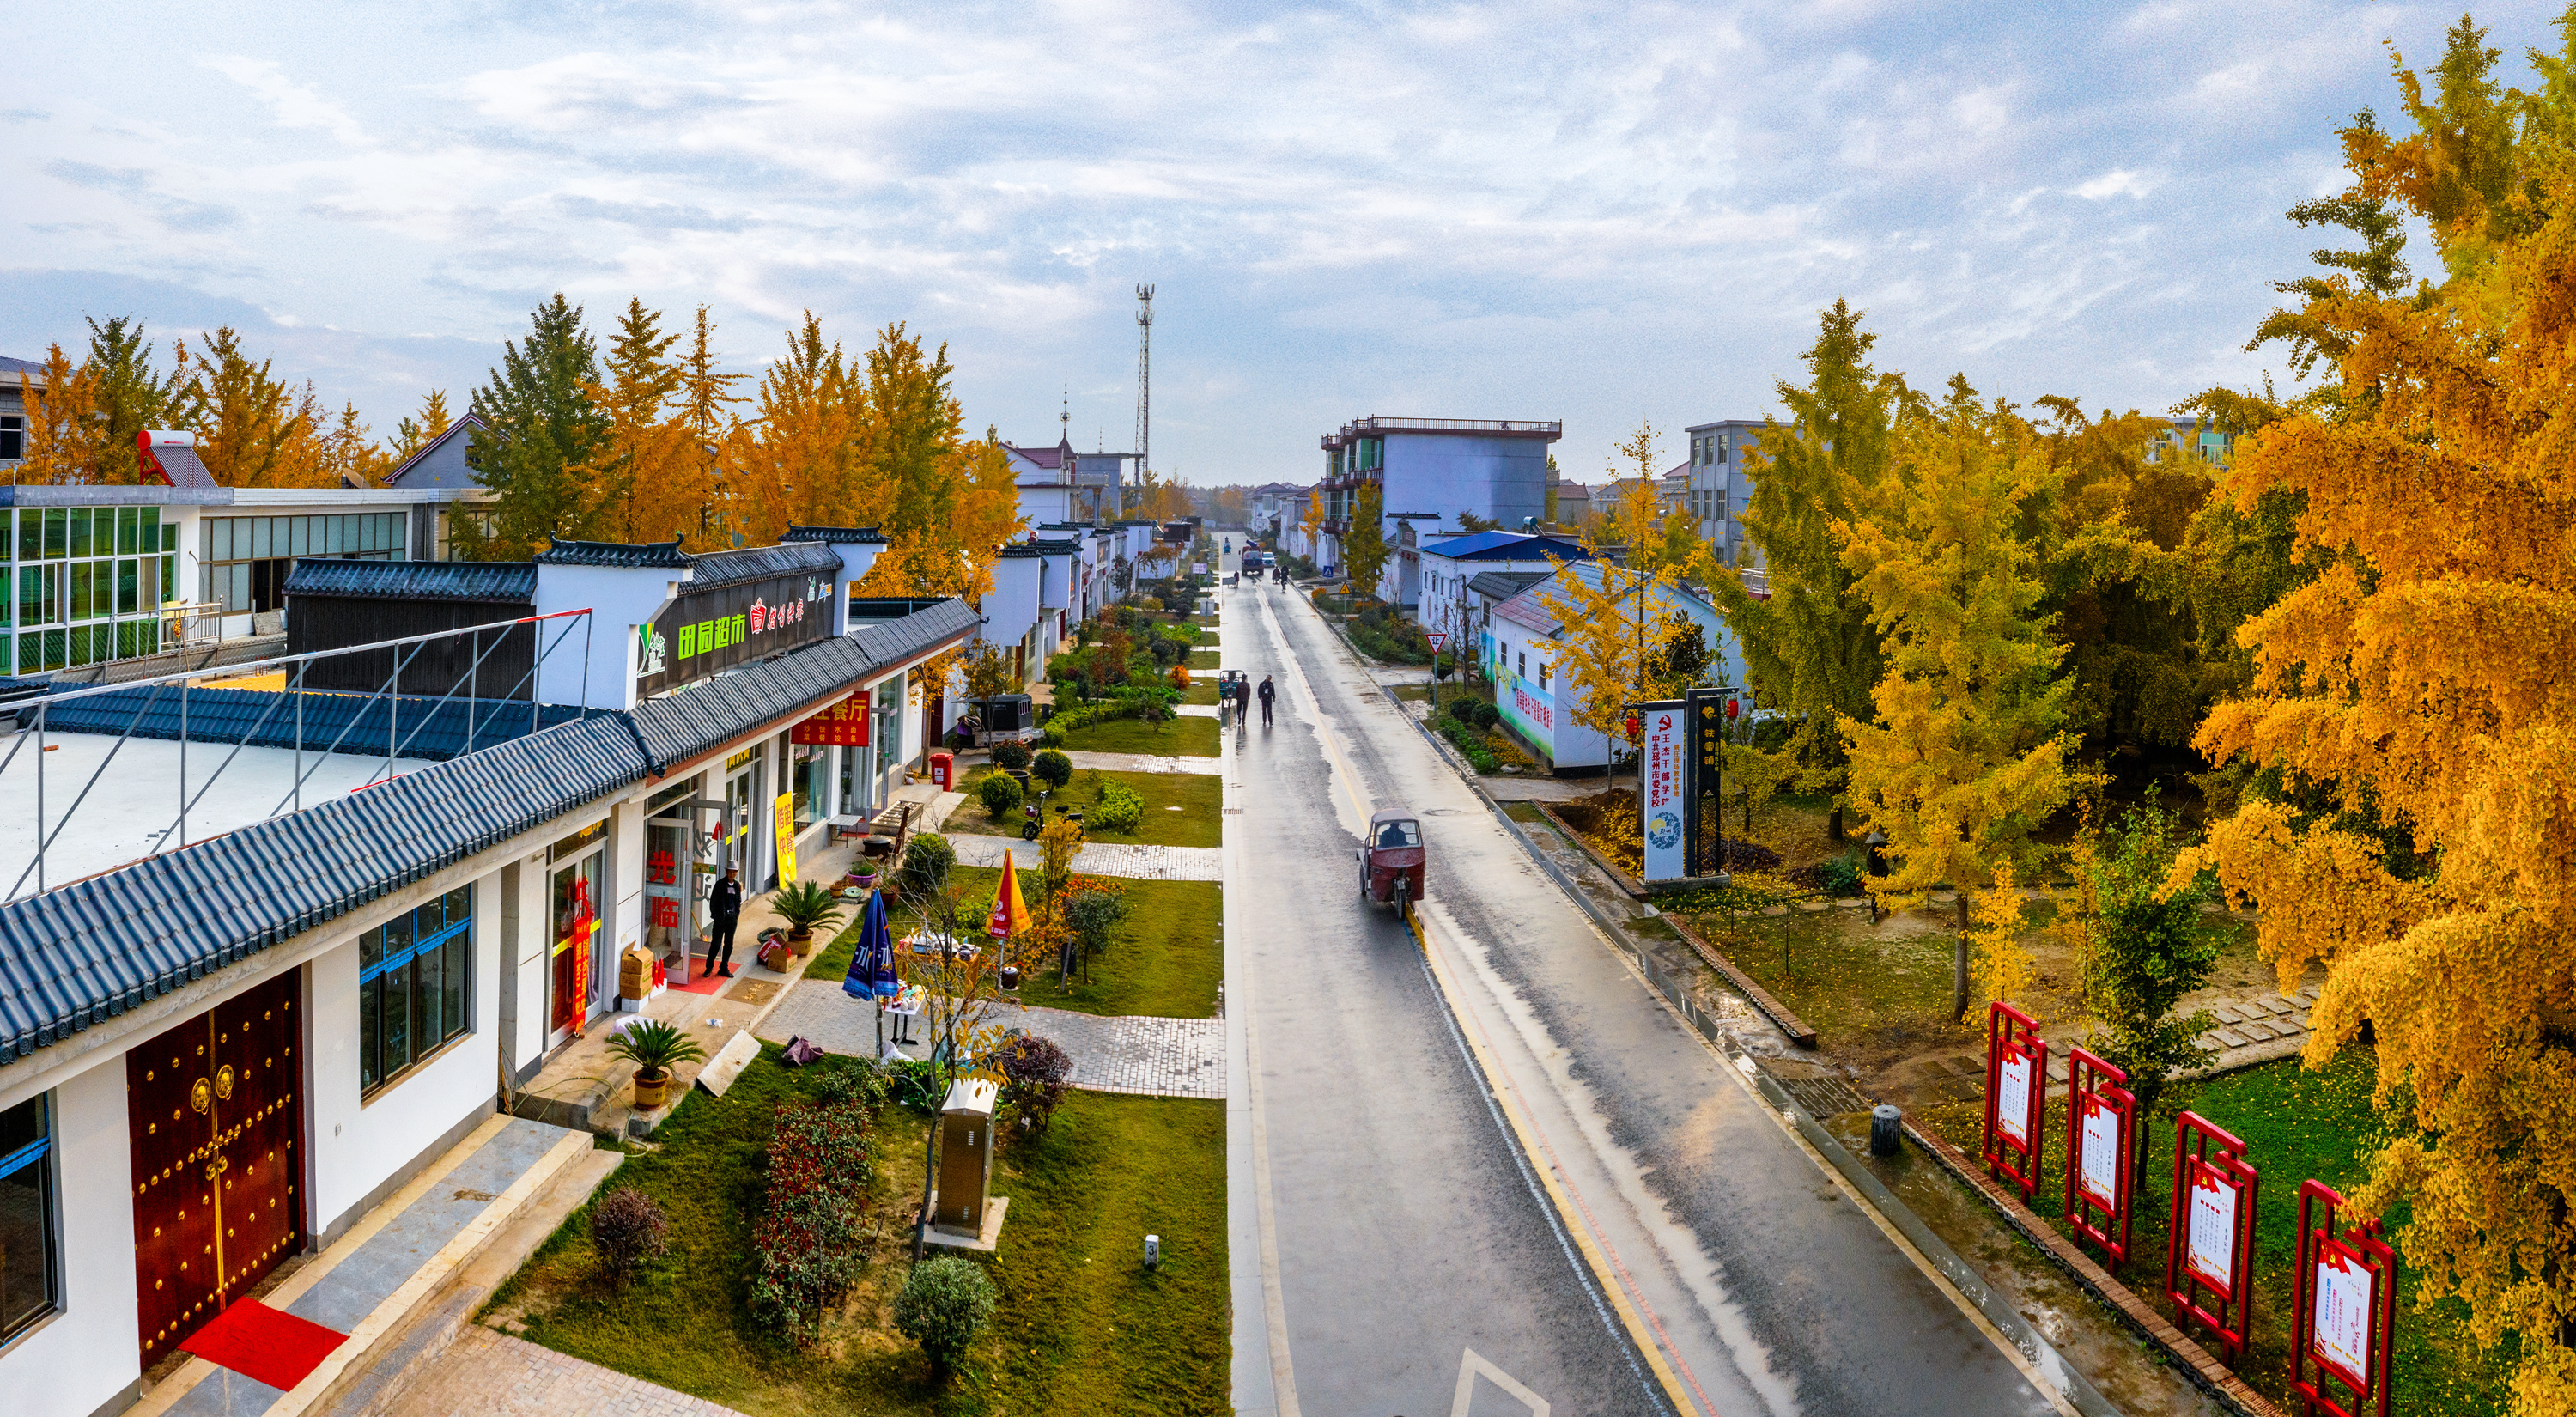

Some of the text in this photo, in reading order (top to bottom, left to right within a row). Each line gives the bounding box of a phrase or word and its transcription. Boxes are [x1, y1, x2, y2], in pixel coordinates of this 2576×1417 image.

[678, 613, 746, 660] 田园超市
[1431, 636, 1440, 645] 让
[804, 725, 811, 741] 炒菜
[819, 725, 826, 742] 快餐
[835, 726, 841, 743] 水饺
[850, 726, 857, 743] 面条
[1651, 734, 1661, 808] 中共邳州市委党校
[778, 830, 794, 859] 快餐
[648, 850, 679, 928] 光临
[1148, 1245, 1155, 1256] 3
